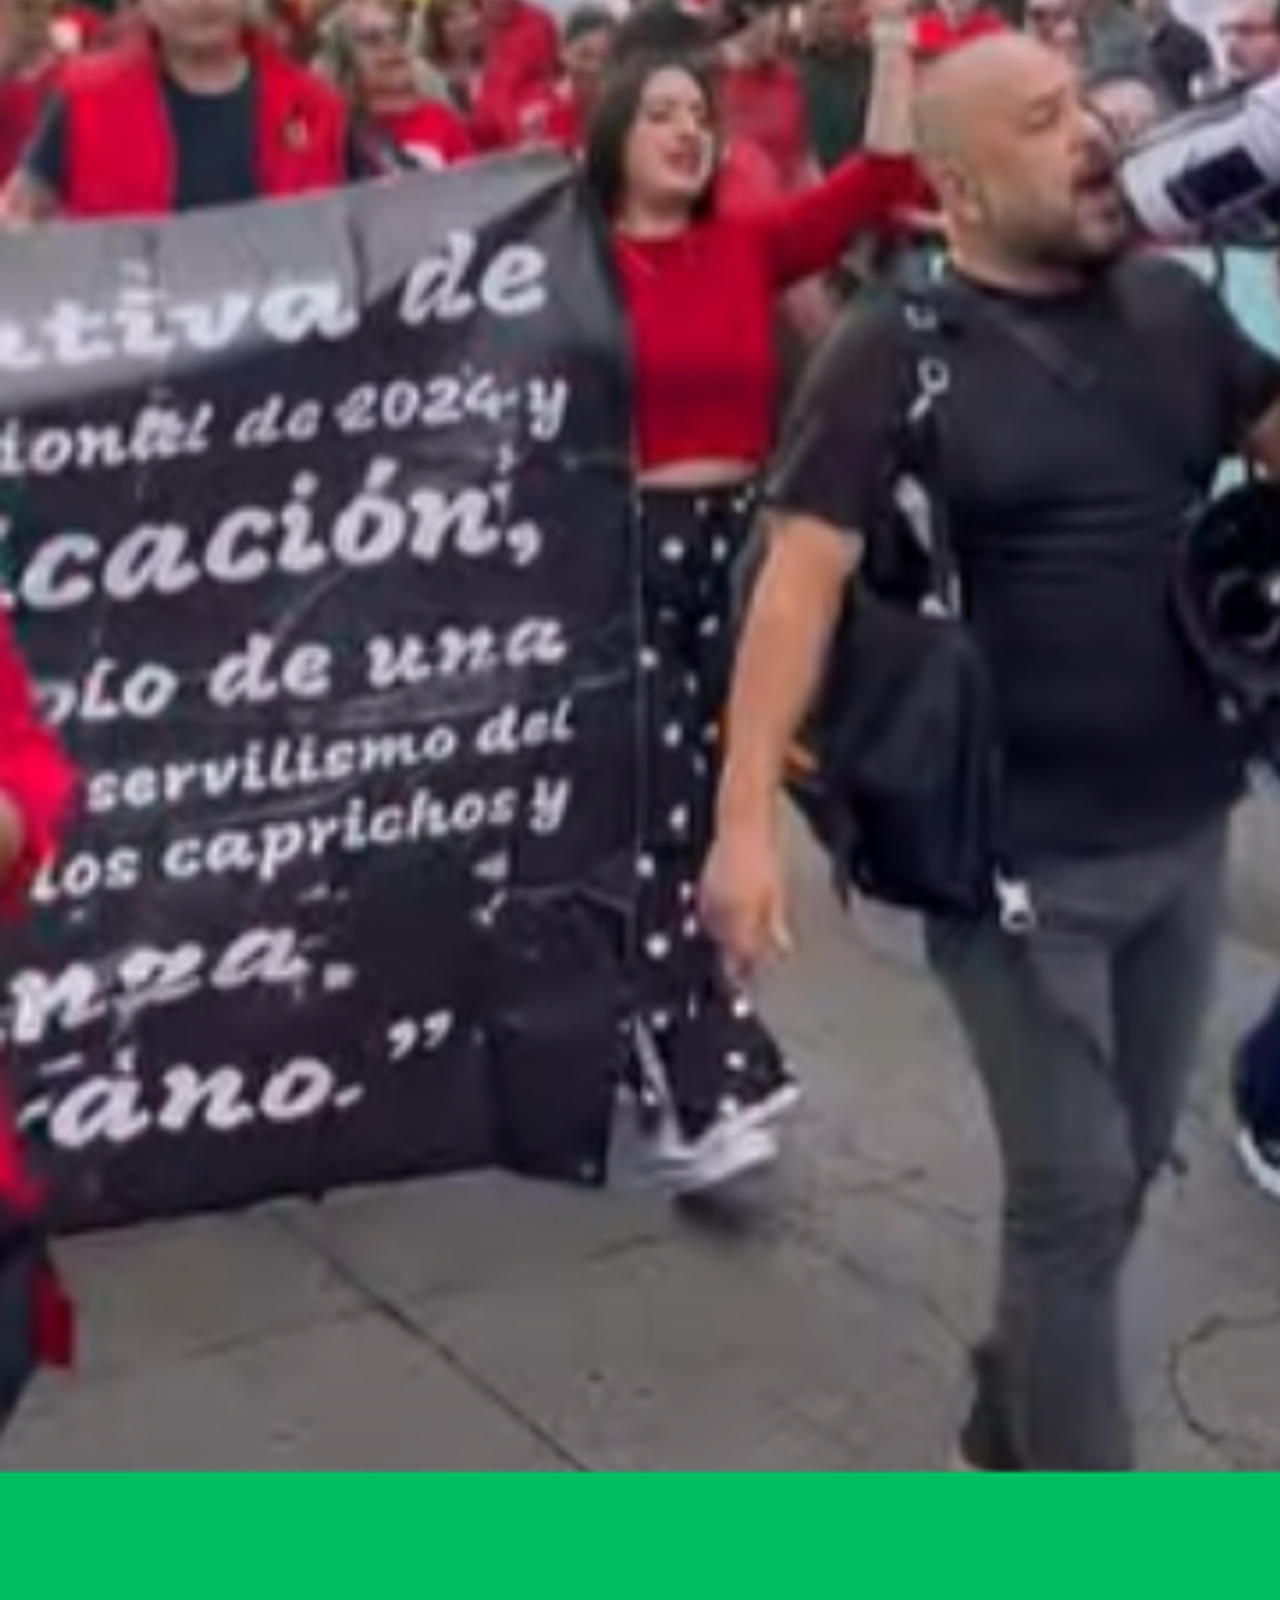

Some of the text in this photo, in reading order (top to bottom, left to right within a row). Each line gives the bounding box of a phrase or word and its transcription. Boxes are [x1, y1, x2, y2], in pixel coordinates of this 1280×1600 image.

[0, 231, 549, 370] tiva de
[0, 373, 568, 475] ional de 2024 y
[0, 456, 543, 611] cación,
[208, 632, 331, 703] de
[367, 615, 568, 688] una
[87, 698, 575, 813] servilismo del
[28, 777, 571, 902] los caprichos y
[0, 925, 357, 1046] nza.
